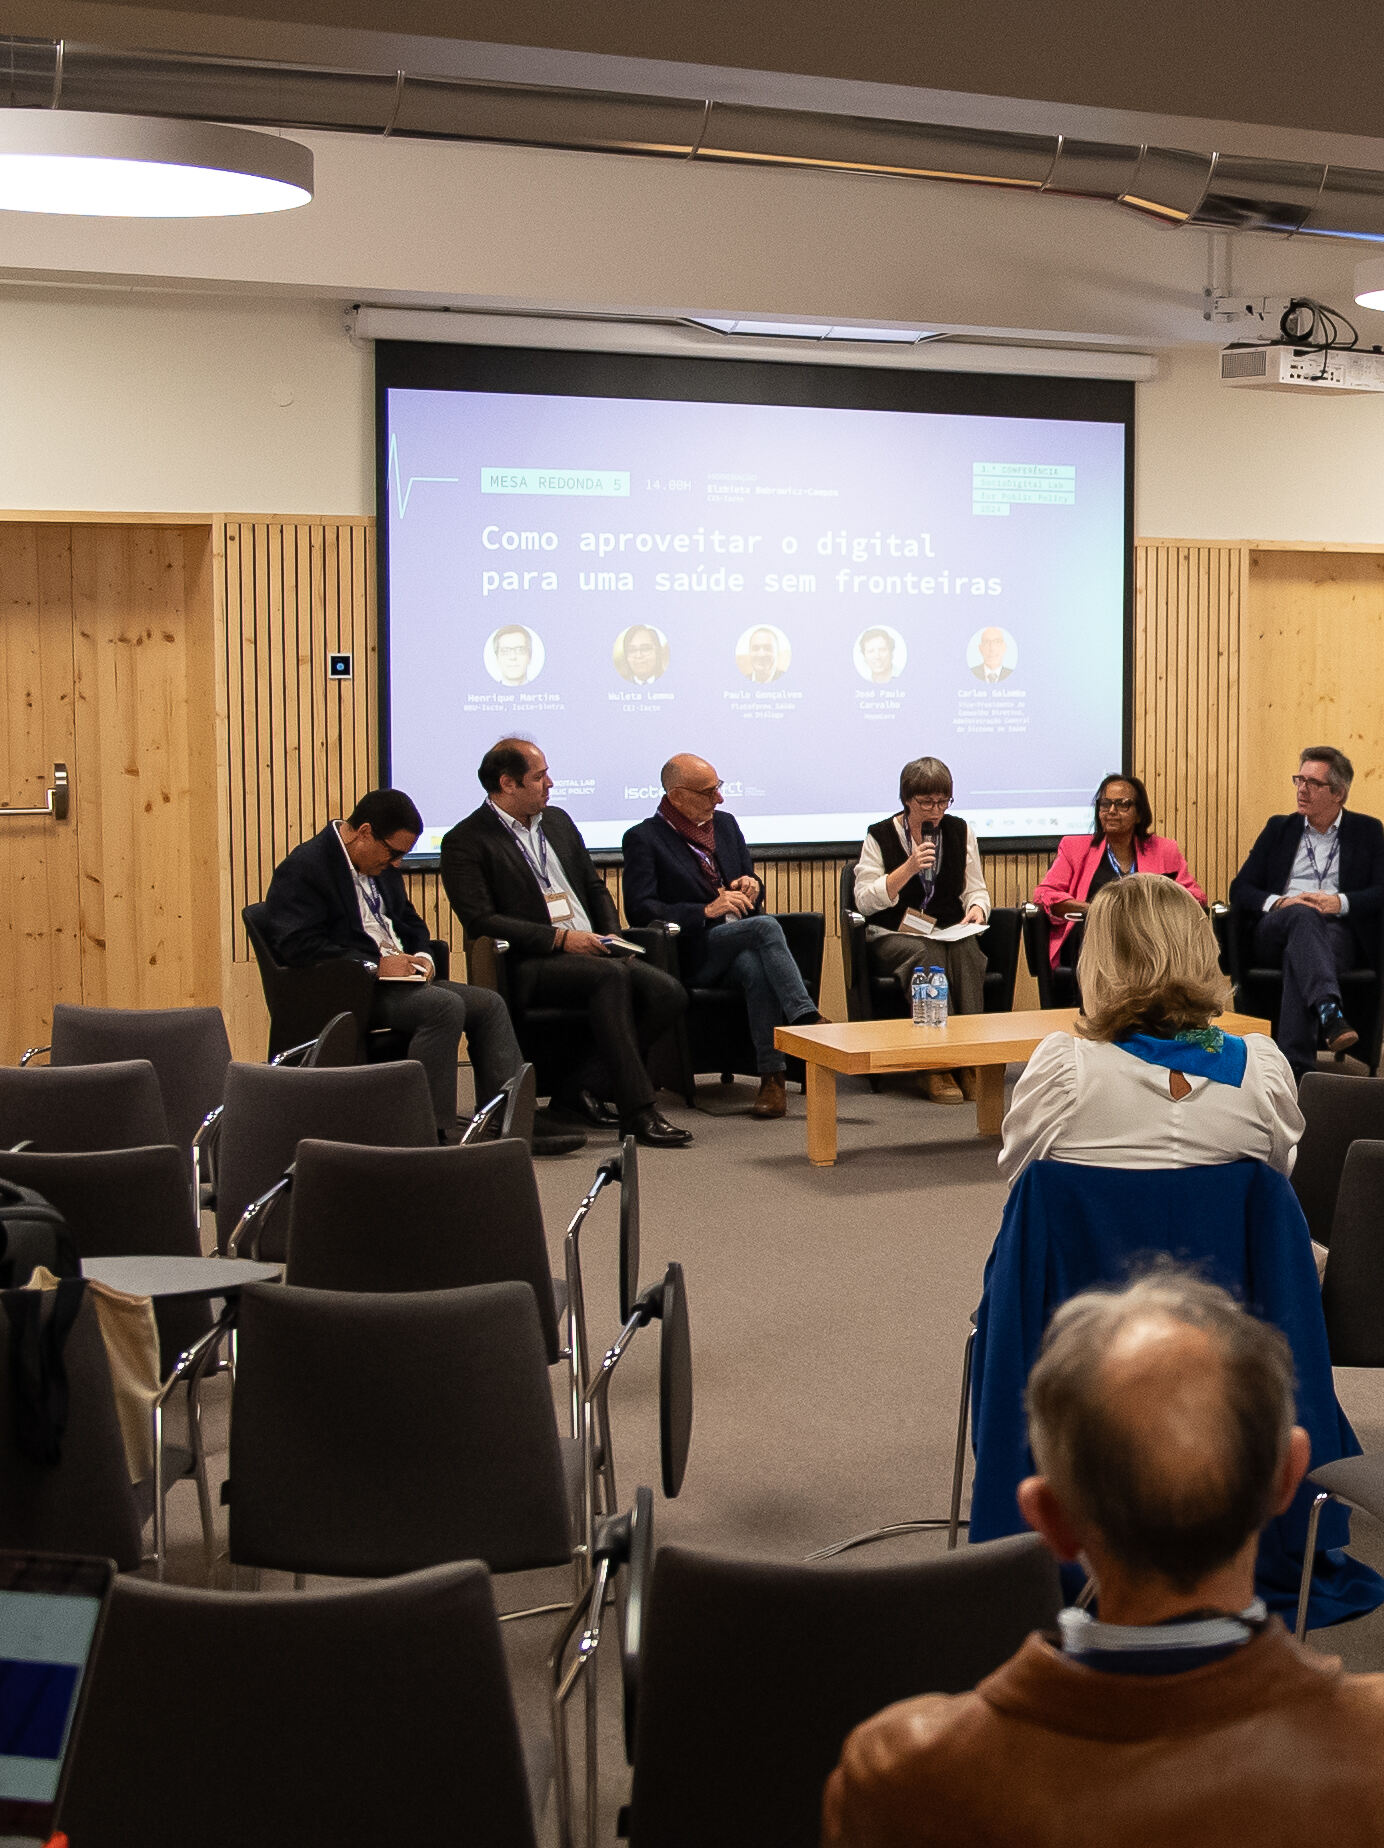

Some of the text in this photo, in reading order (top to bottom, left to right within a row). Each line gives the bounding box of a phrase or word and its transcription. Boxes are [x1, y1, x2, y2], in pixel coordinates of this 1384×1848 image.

[490, 475, 622, 491] MESA REDONDA 5
[646, 479, 692, 491] 14.00H
[482, 525, 936, 563] Como aproveitar o digital
[483, 564, 1002, 596] para uma saúde sem fronteiras
[467, 691, 561, 704] Henrique Martins
[568, 787, 596, 796] POLICY
